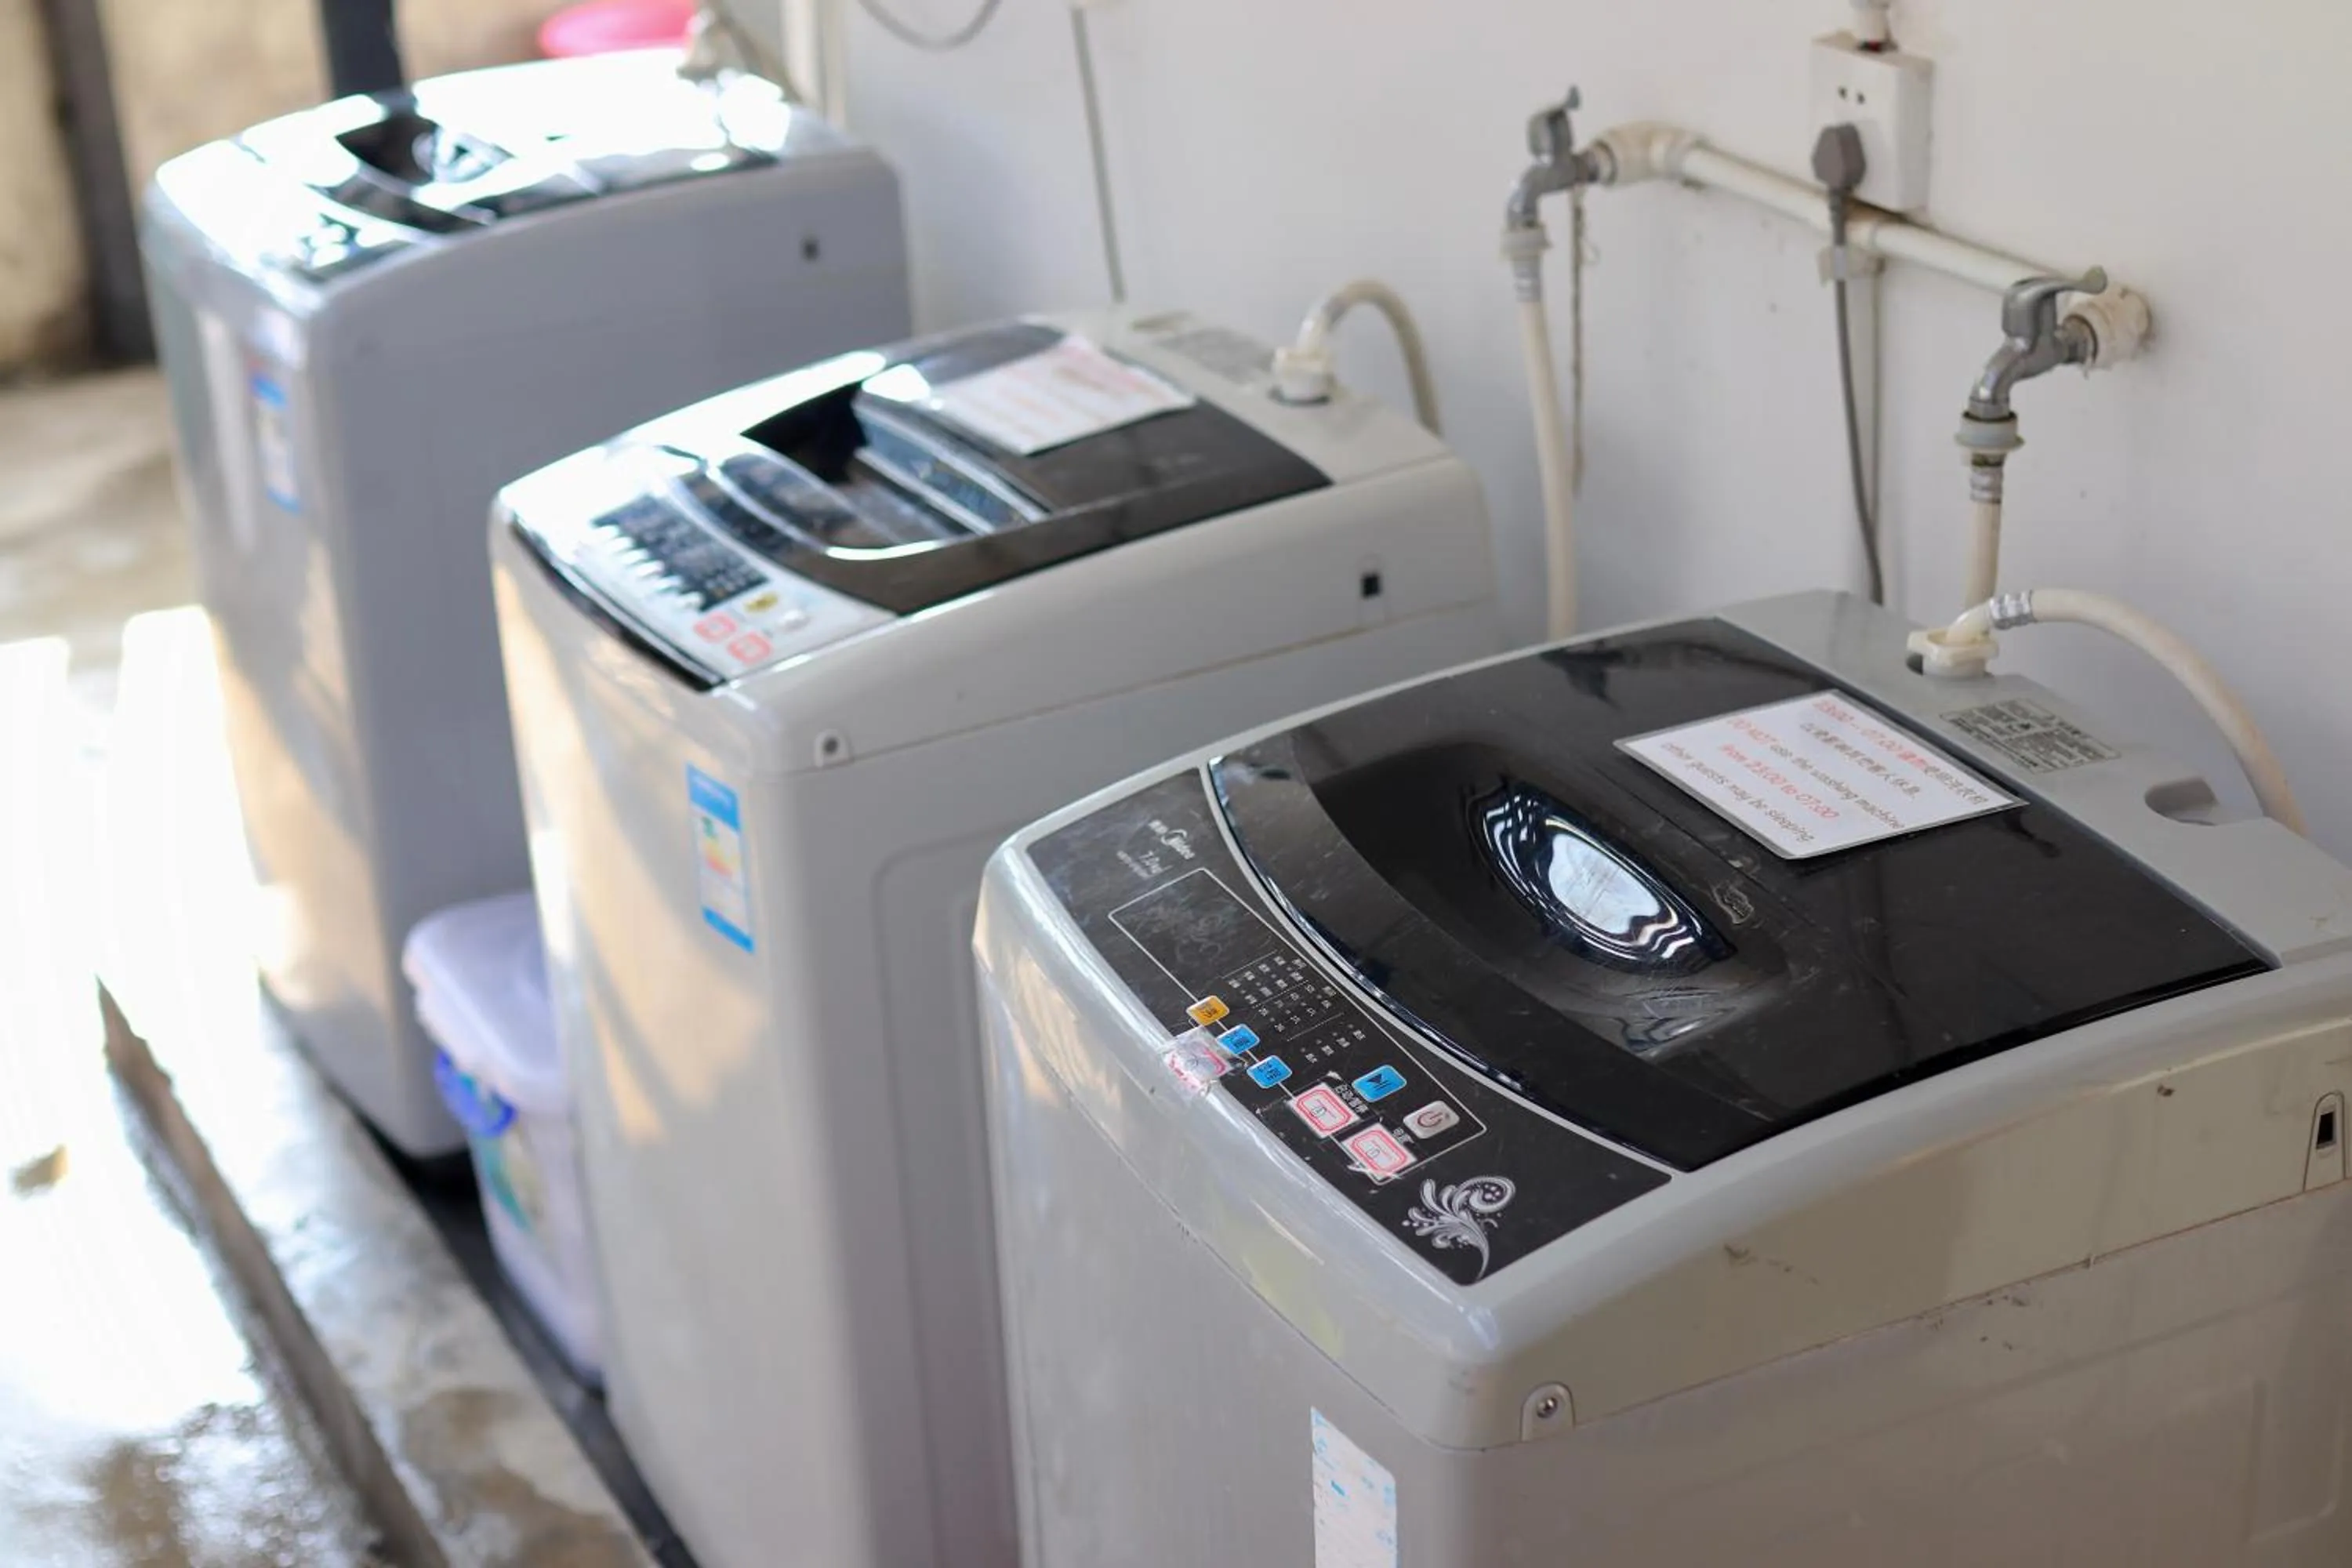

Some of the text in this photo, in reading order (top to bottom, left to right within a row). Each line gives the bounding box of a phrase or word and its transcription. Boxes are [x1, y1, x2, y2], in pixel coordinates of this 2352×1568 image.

[1719, 743, 1841, 818] from 23:00 to 07:00
